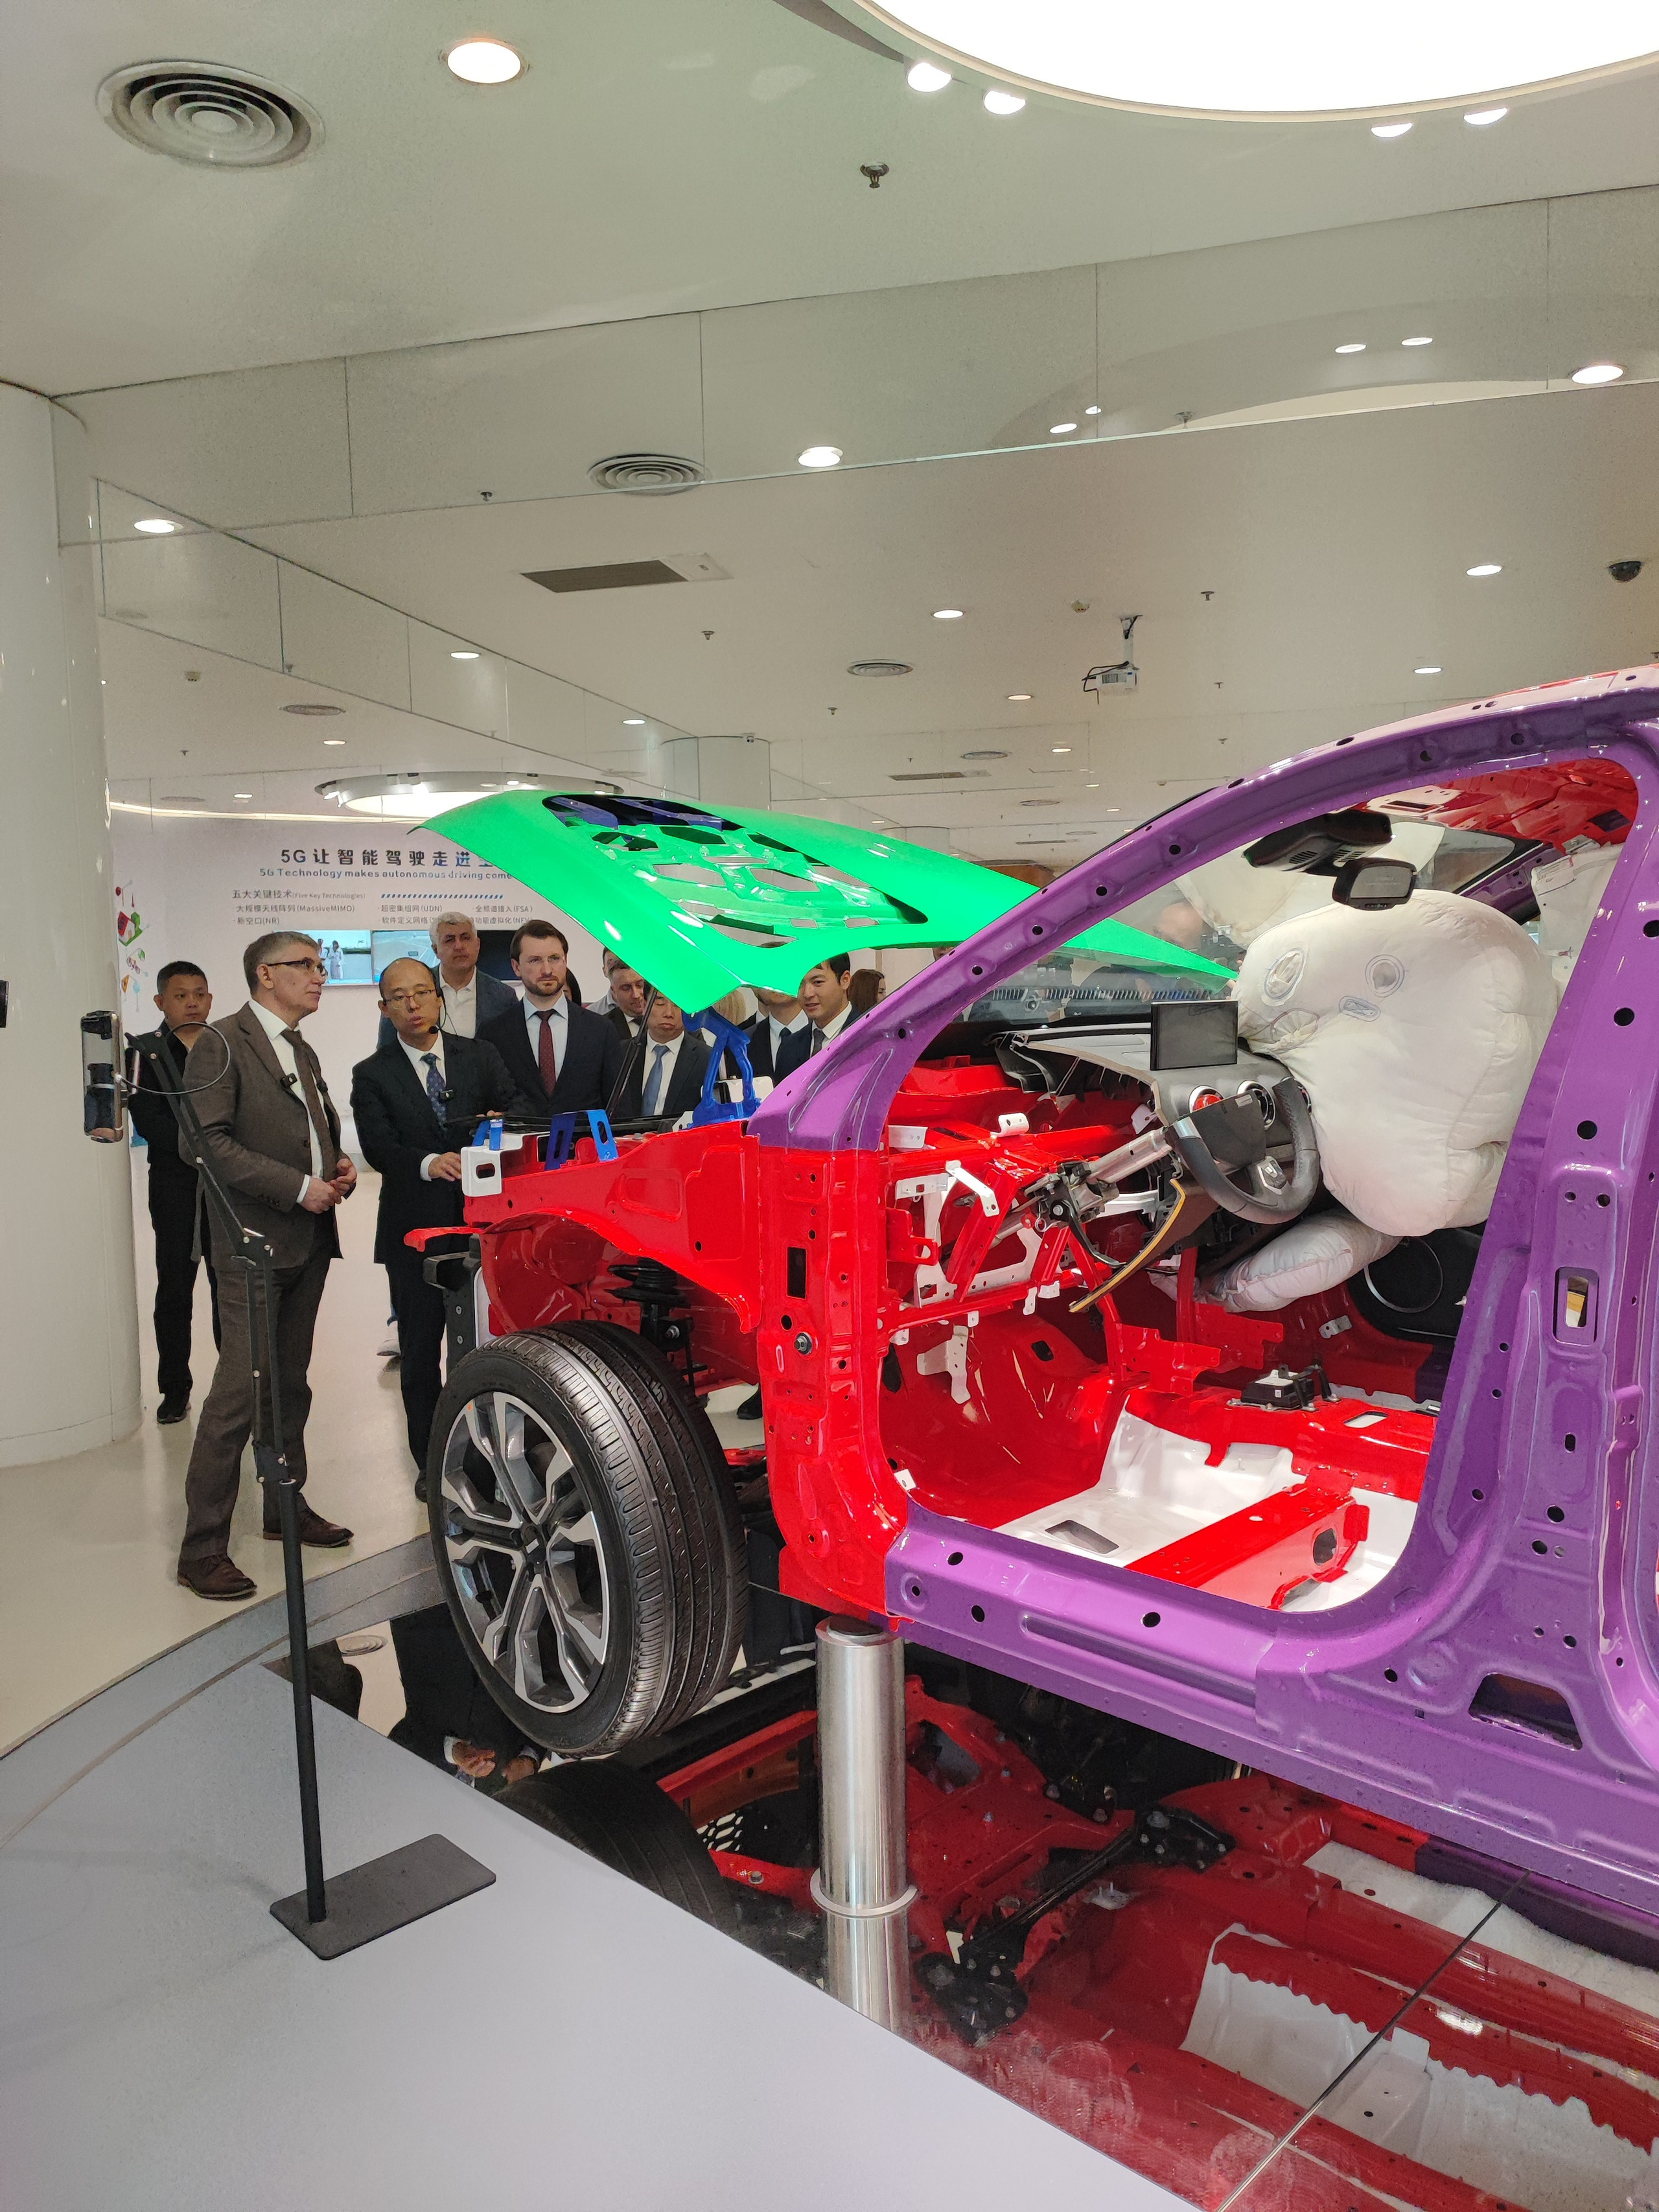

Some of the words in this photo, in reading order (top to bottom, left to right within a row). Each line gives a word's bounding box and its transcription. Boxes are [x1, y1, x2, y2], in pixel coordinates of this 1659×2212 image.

[260, 868, 274, 877] 5G
[277, 868, 342, 879] Technology
[345, 869, 380, 878] makes
[448, 870, 483, 880] driving
